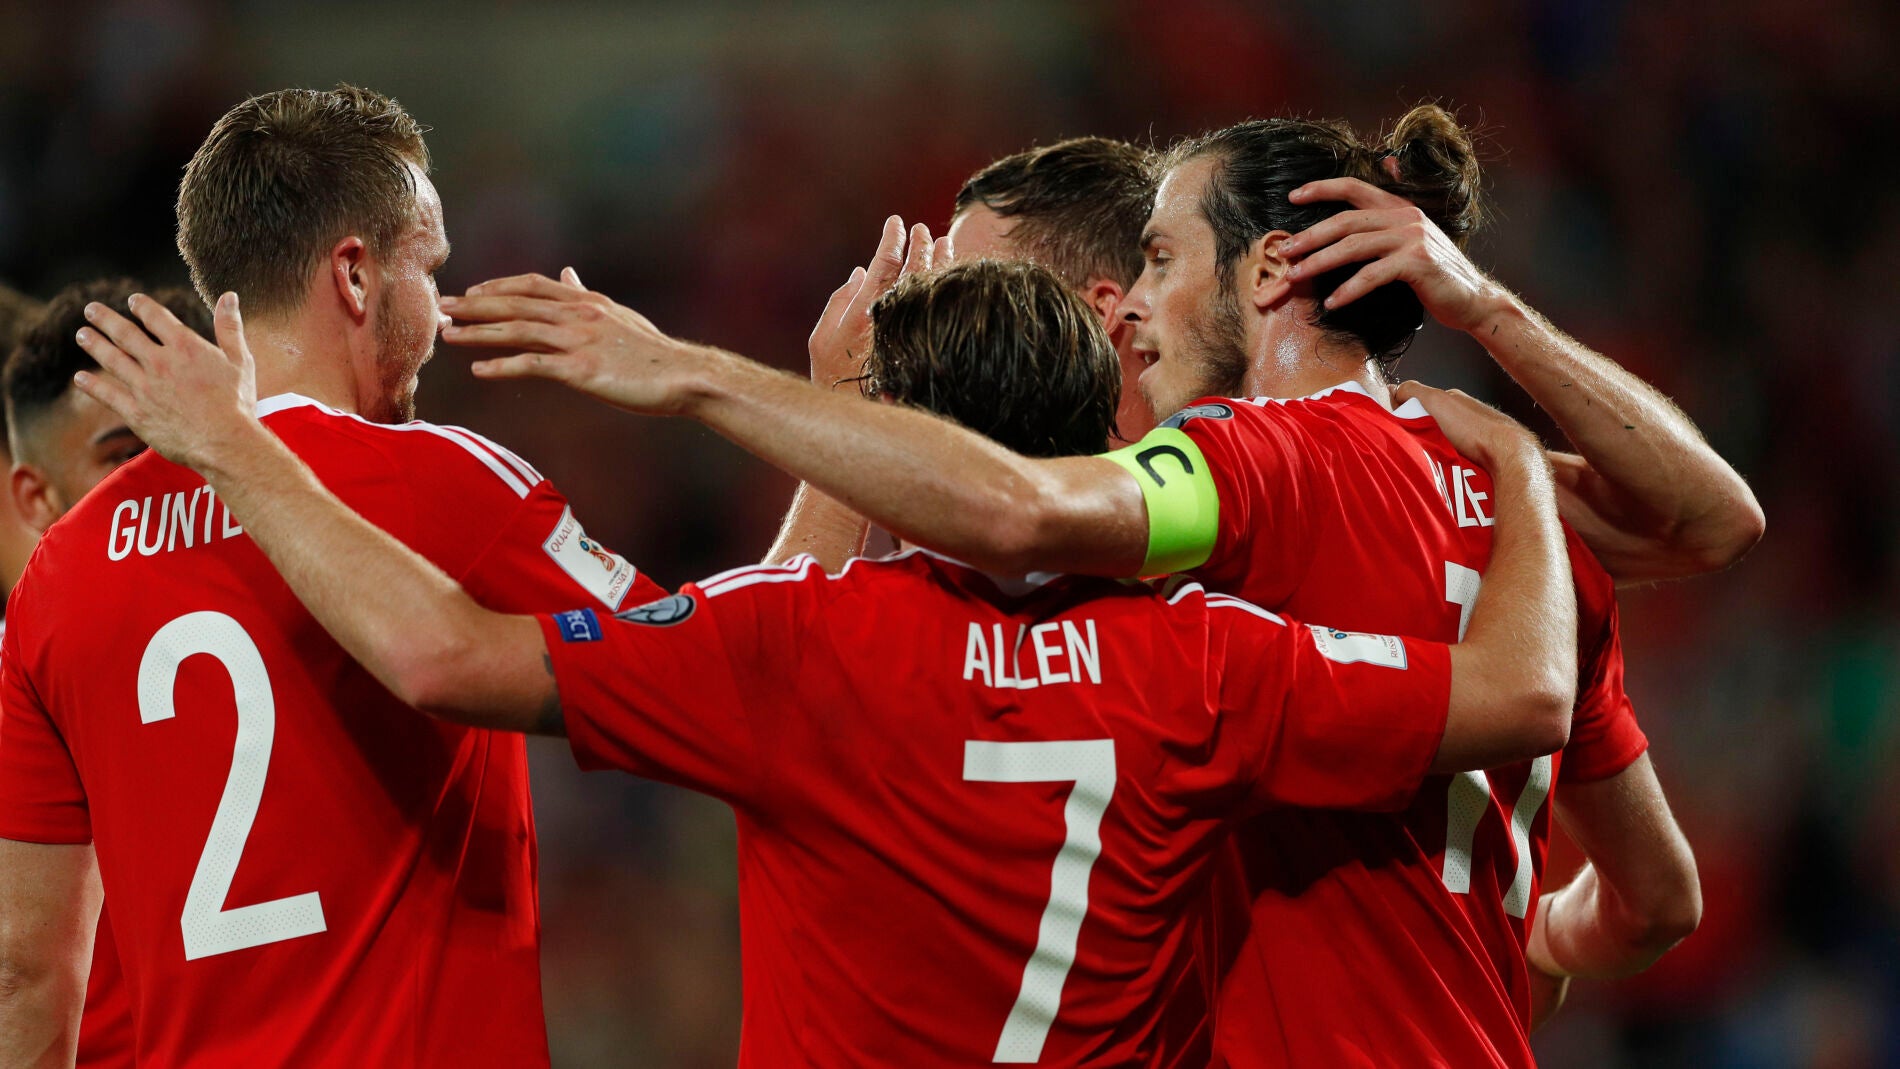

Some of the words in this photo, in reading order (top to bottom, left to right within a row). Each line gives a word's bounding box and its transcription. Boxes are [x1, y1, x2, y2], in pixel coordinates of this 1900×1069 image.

[1135, 445, 1194, 488] C
[963, 619, 1102, 690] ALLEN
[137, 611, 328, 962] 2
[962, 738, 1117, 1063] 7
